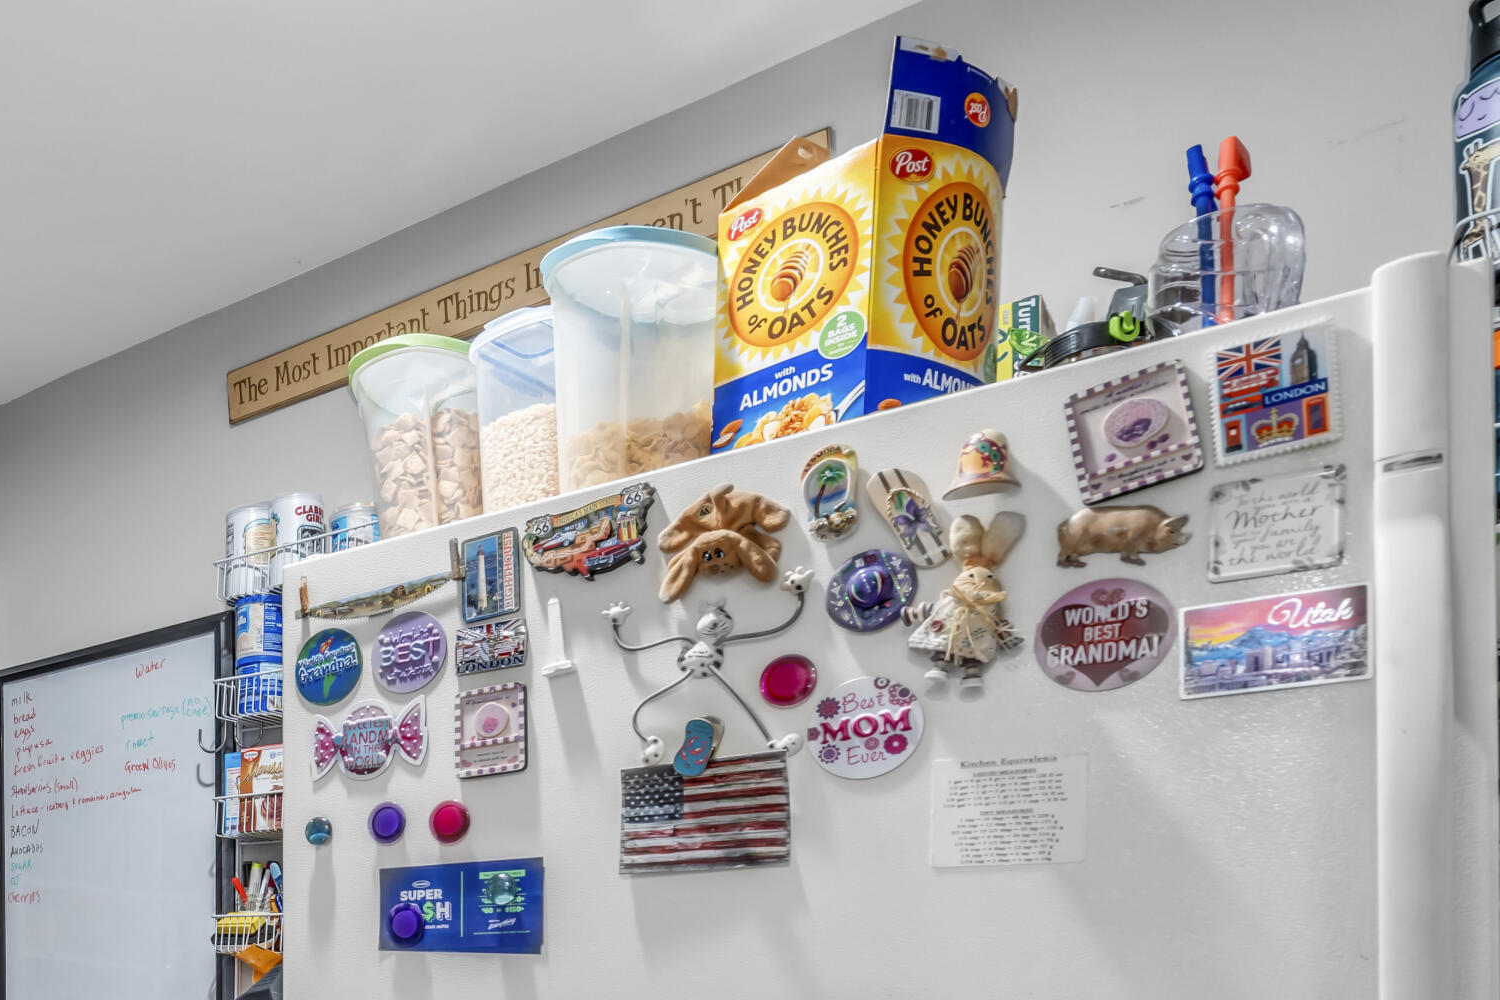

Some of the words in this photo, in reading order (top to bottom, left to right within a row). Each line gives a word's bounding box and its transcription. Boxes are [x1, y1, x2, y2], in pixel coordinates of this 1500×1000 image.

[969, 98, 990, 124] Post
[894, 151, 931, 177] Post
[728, 209, 762, 233] Post
[783, 211, 850, 273] BUNCHES
[912, 203, 958, 278] HONEY
[962, 192, 995, 306] BUNCHES
[736, 229, 778, 312] HONEY
[767, 286, 835, 340] OATS
[836, 316, 847, 328] 2
[233, 376, 269, 405] The
[274, 352, 320, 392] Most
[437, 276, 516, 324] Things
[824, 330, 860, 347] INSIDE
[827, 325, 858, 340] BAGS
[941, 315, 987, 352] OATS
[774, 364, 796, 379] with
[903, 371, 922, 384] with
[739, 363, 834, 412] ALMONDS
[1263, 380, 1327, 406] LONDON
[625, 489, 642, 506] 66
[305, 513, 324, 526] GIRL
[534, 522, 550, 535] 66
[564, 521, 586, 532] MOTEL
[502, 530, 515, 611] LIGHTHOUSE
[1064, 599, 1149, 627] WORLD'S
[1267, 596, 1354, 628] Utah
[1082, 622, 1125, 643] BEST
[379, 635, 442, 668] BEST
[1047, 632, 1162, 668] GRANDMA!
[135, 657, 166, 680] Water
[298, 650, 359, 685] Grandpa!
[456, 655, 525, 676] LONDON
[11, 690, 34, 707] milk
[841, 691, 887, 714] Best
[13, 707, 37, 725] bread
[819, 705, 913, 744] MOM
[14, 724, 36, 745] eggs
[69, 743, 104, 766] veggies
[362, 743, 382, 753] THE
[846, 745, 889, 768] Ever
[10, 819, 41, 839] BACON
[10, 843, 44, 859] AVOCADOS
[400, 888, 443, 902] SUPER
